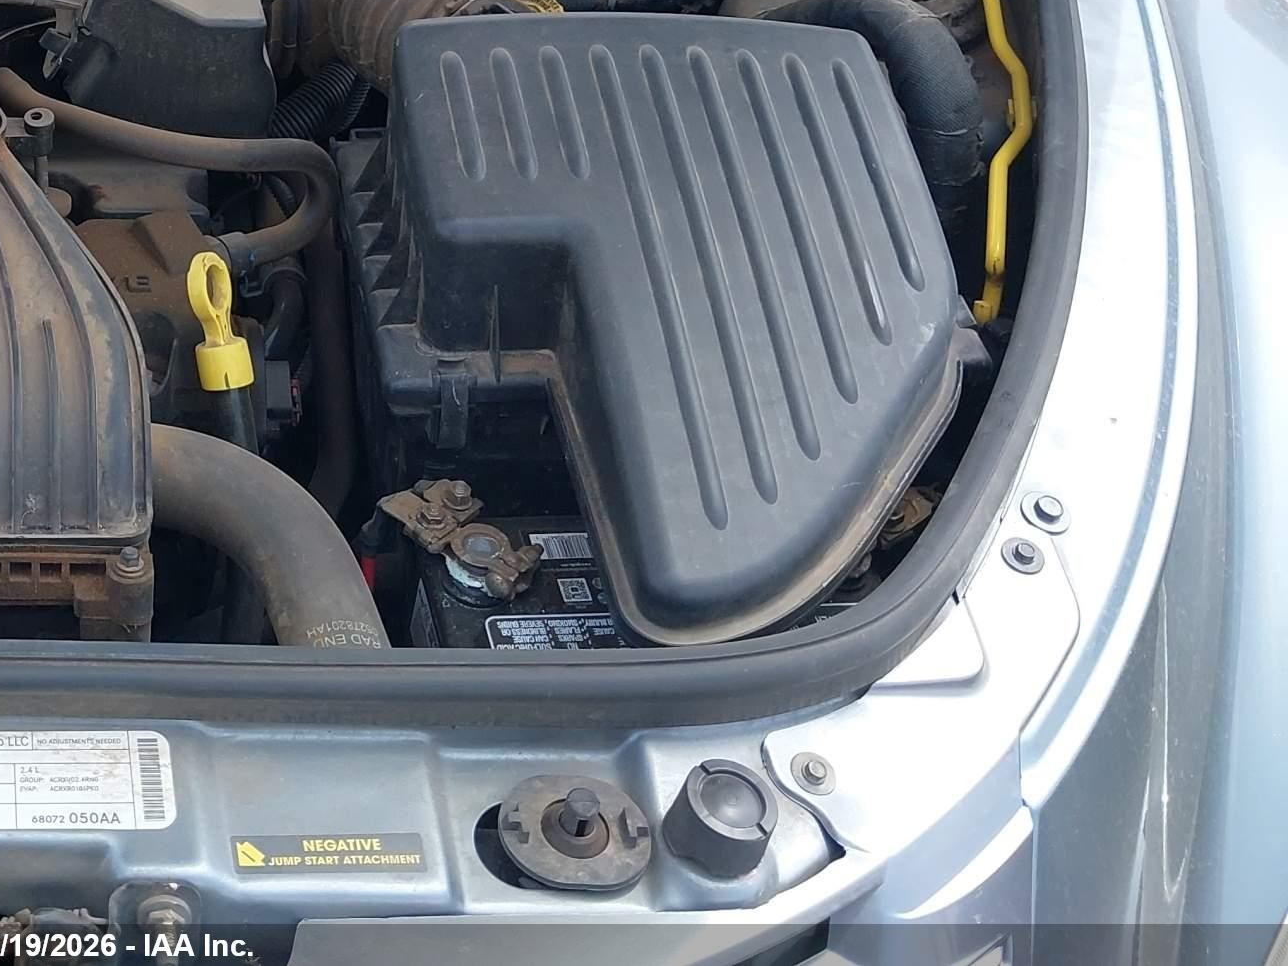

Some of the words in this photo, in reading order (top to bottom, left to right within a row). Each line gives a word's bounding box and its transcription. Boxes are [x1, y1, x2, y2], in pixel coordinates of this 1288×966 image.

[518, 619, 545, 628] SEVERE
[350, 633, 381, 649] RAD
[512, 635, 535, 644] CAUSE
[8, 736, 29, 747] LLC
[95, 737, 122, 745] NEEDED
[31, 814, 65, 824] 68072
[68, 812, 121, 824] 050AA
[302, 838, 382, 852] NEGATIVE
[268, 856, 302, 867] JUMP
[304, 855, 340, 866] START
[343, 854, 421, 865] ATTACHMENT
